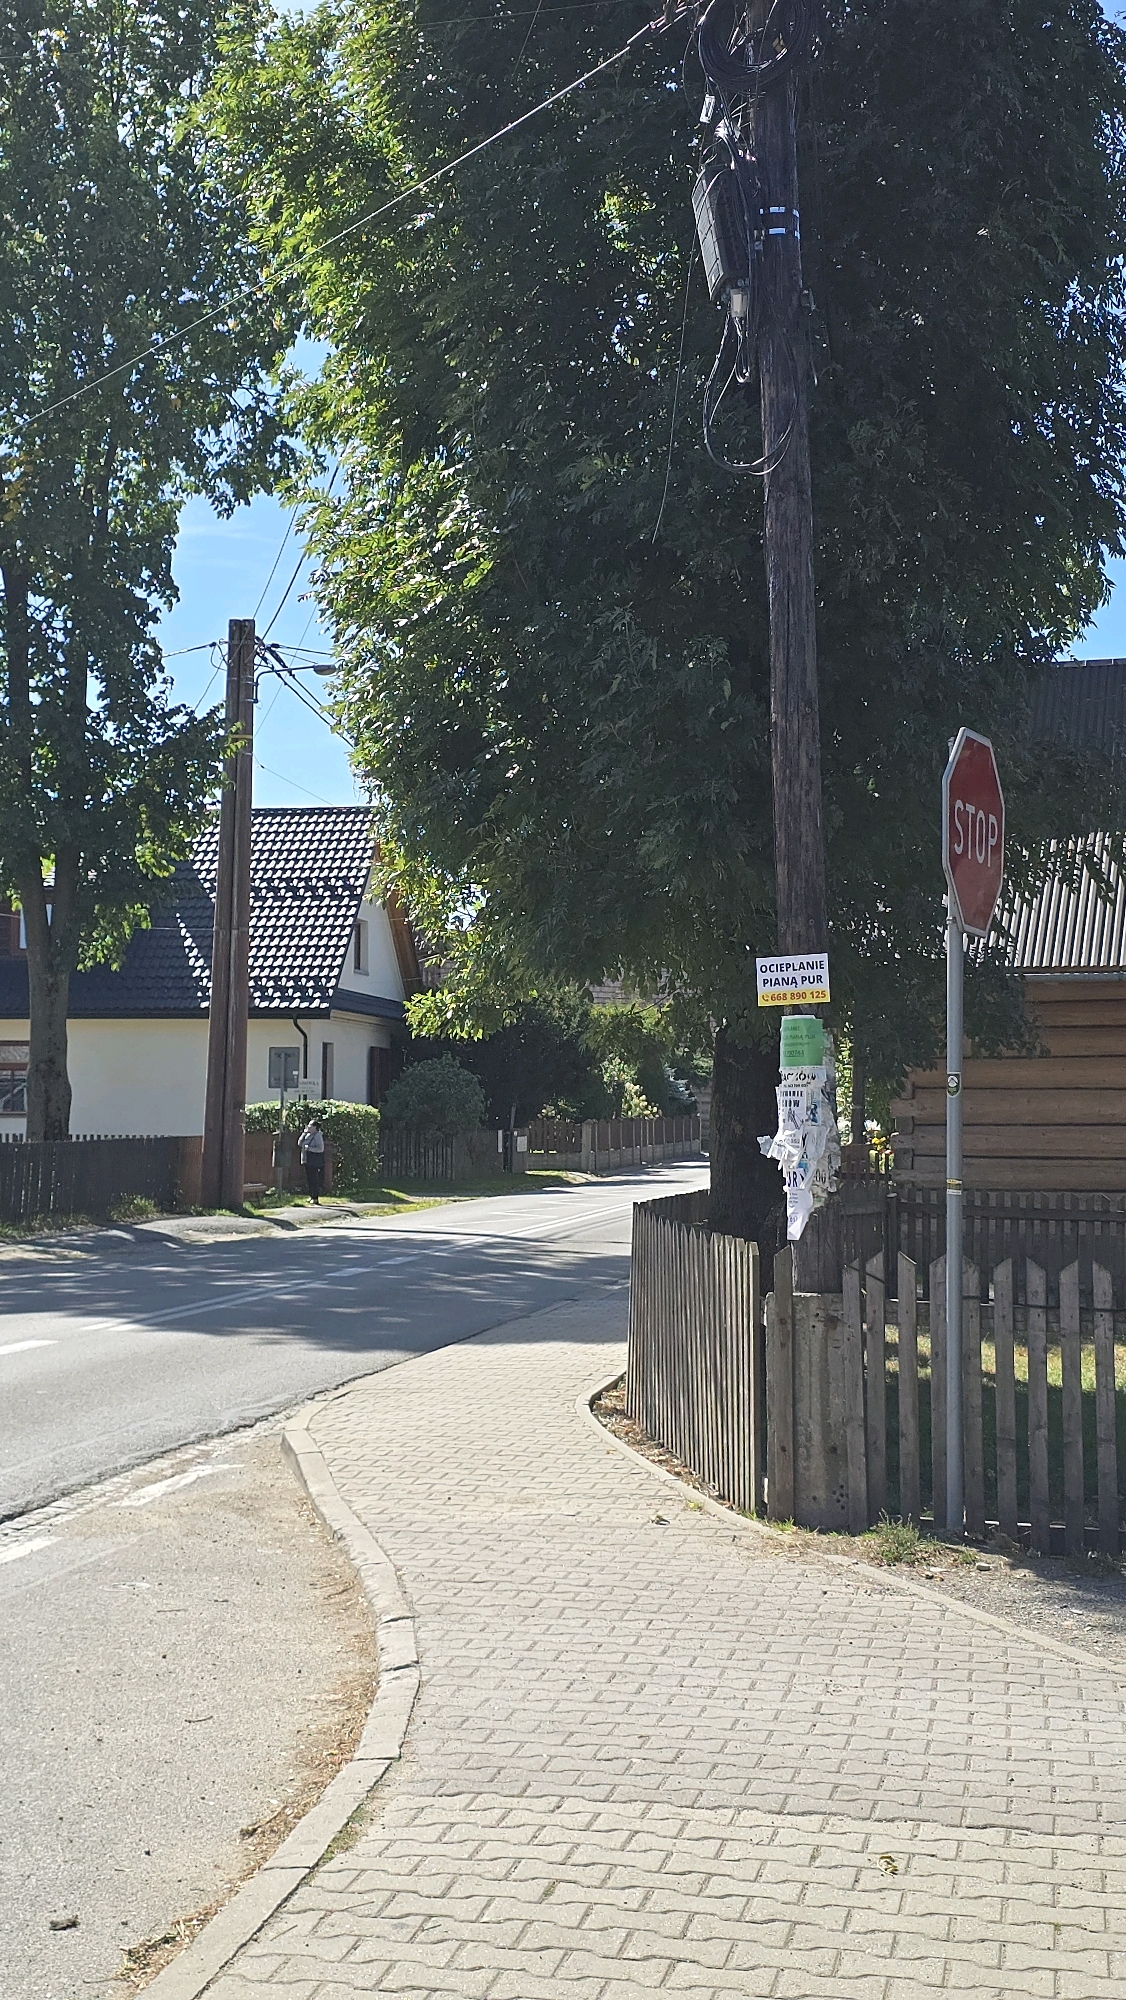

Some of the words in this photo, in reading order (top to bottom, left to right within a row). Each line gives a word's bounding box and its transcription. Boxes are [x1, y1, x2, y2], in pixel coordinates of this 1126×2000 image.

[954, 799, 998, 867] STOP
[760, 960, 825, 973] OCIEPLANIE
[762, 976, 798, 988] PIANĄ
[801, 974, 823, 985] PUR
[770, 993, 787, 1002] 668
[790, 991, 807, 1000] 890
[810, 990, 826, 999] 125
